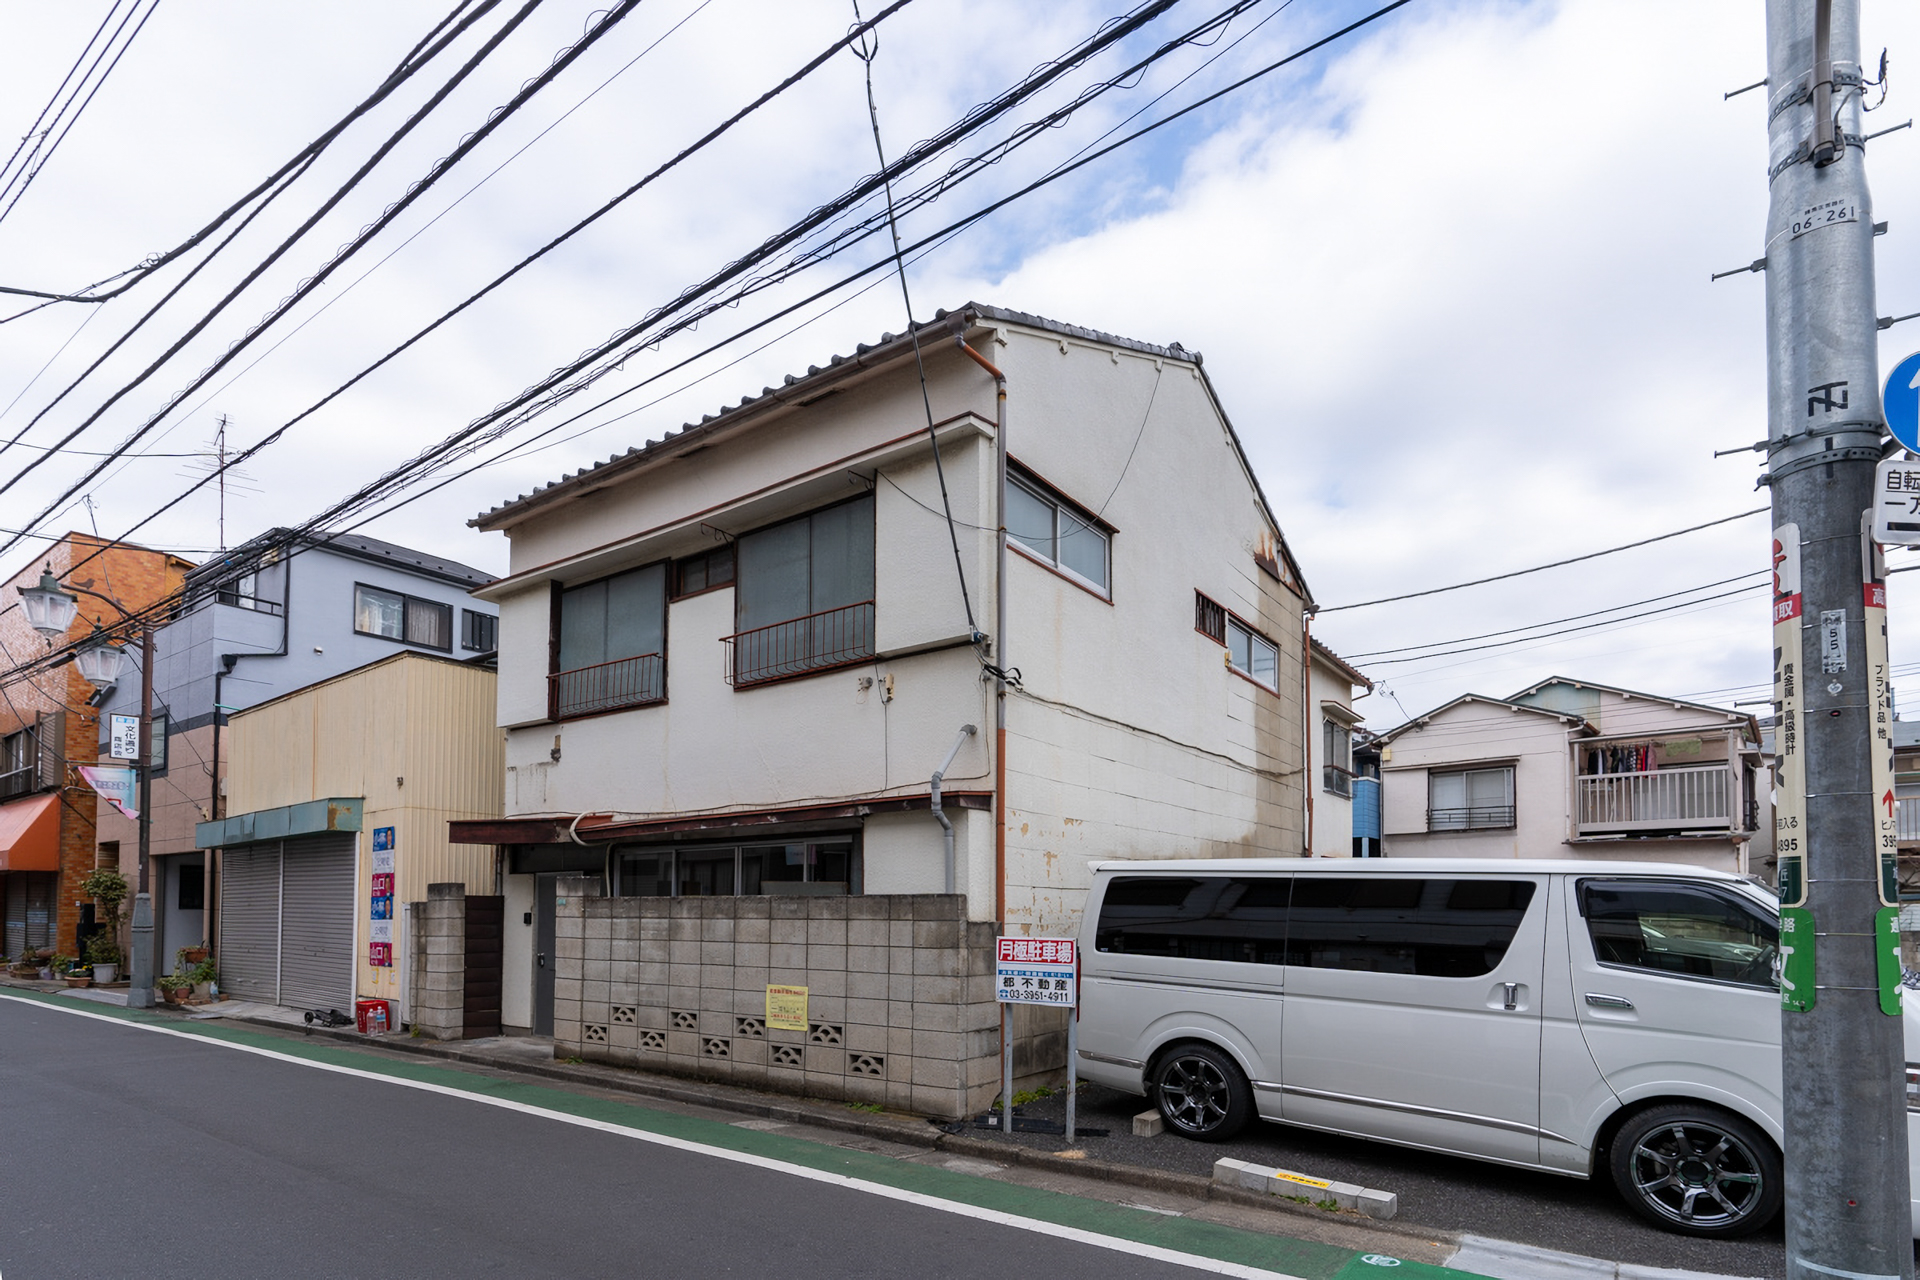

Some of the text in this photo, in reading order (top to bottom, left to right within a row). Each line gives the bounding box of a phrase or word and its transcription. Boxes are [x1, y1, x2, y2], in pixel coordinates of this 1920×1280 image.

[1792, 206, 1855, 234] 06-261
[1875, 664, 1887, 723] ブランド品
[125, 726, 136, 754] 文化通り
[1000, 941, 1072, 962] 月極駐車場
[1010, 989, 1068, 1002] 03-3951-4911
